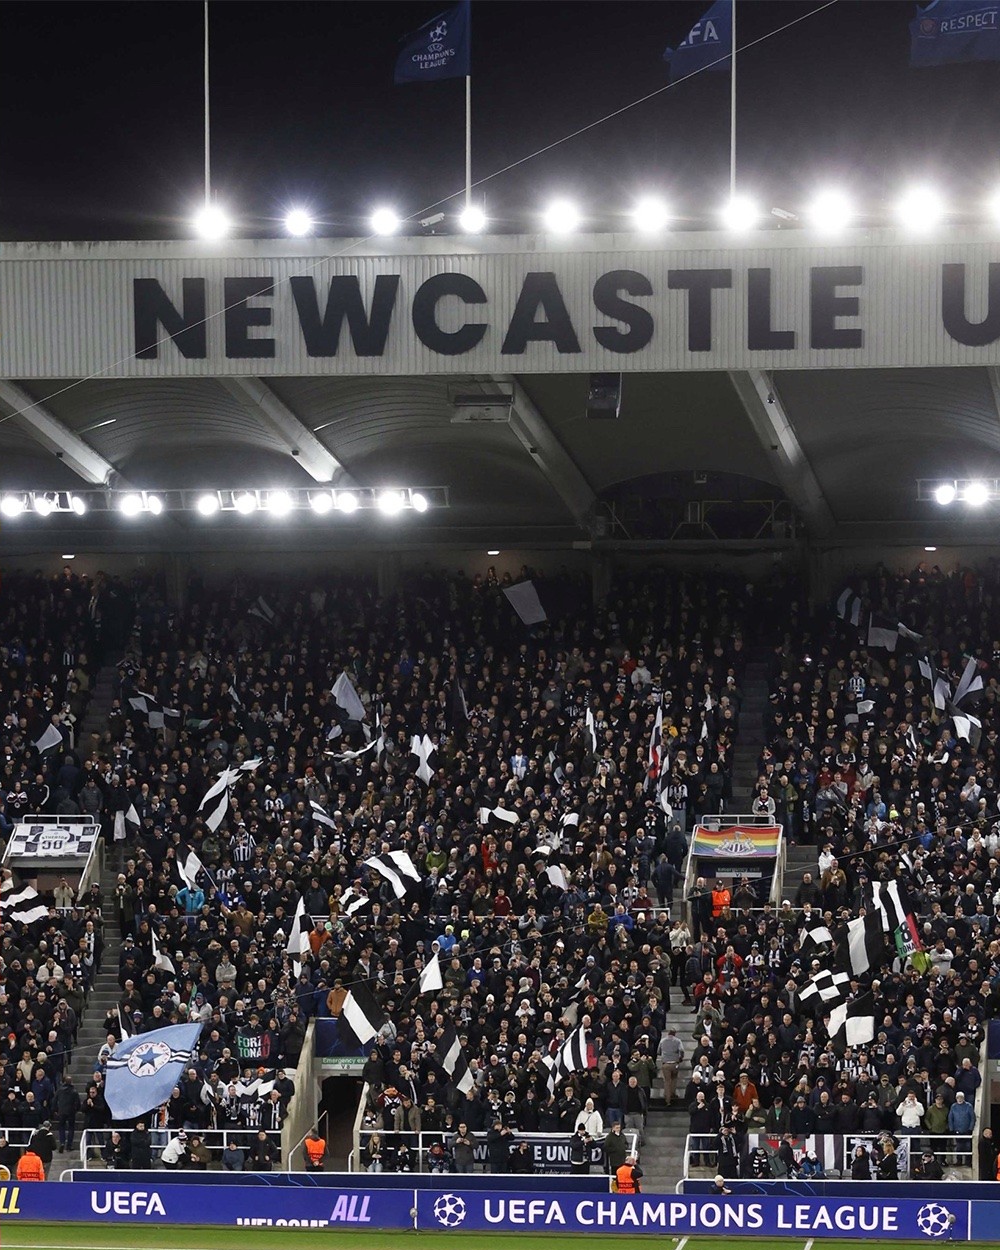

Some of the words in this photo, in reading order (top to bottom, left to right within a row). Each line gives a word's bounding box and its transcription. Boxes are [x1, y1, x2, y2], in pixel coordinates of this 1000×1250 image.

[680, 20, 719, 46] FA
[940, 11, 998, 33] RESPECT
[133, 266, 863, 361] NEWCASTLE
[901, 921, 912, 942] 8
[91, 1190, 167, 1216] UEFA
[329, 1194, 372, 1222] ALL
[483, 1199, 566, 1224] UEFA
[575, 1200, 763, 1228] CHAMPIONS
[777, 1204, 899, 1231] LEAGUE
